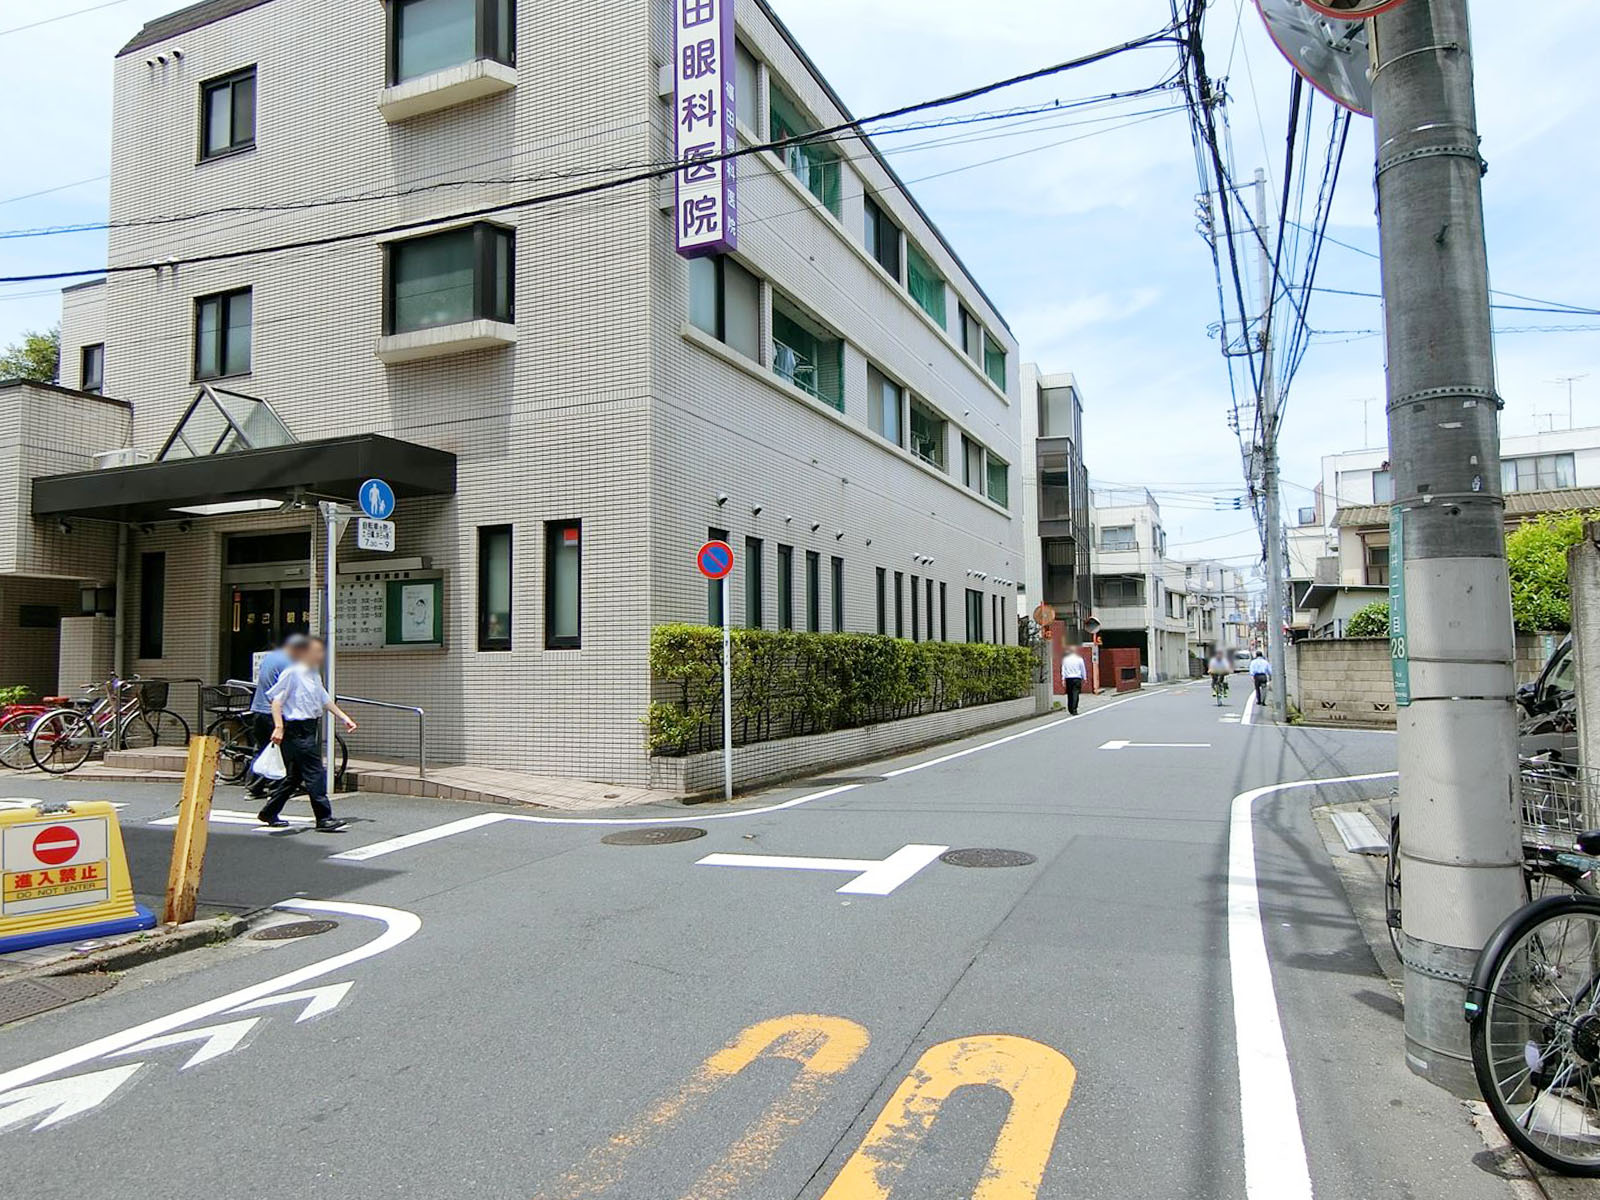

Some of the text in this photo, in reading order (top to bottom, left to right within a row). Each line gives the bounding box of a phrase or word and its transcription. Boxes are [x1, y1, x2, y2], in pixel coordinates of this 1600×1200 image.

[1391, 637, 1405, 659] 28
[14, 866, 98, 889] 進入禁止
[16, 882, 96, 900] DO NOT ENTER
